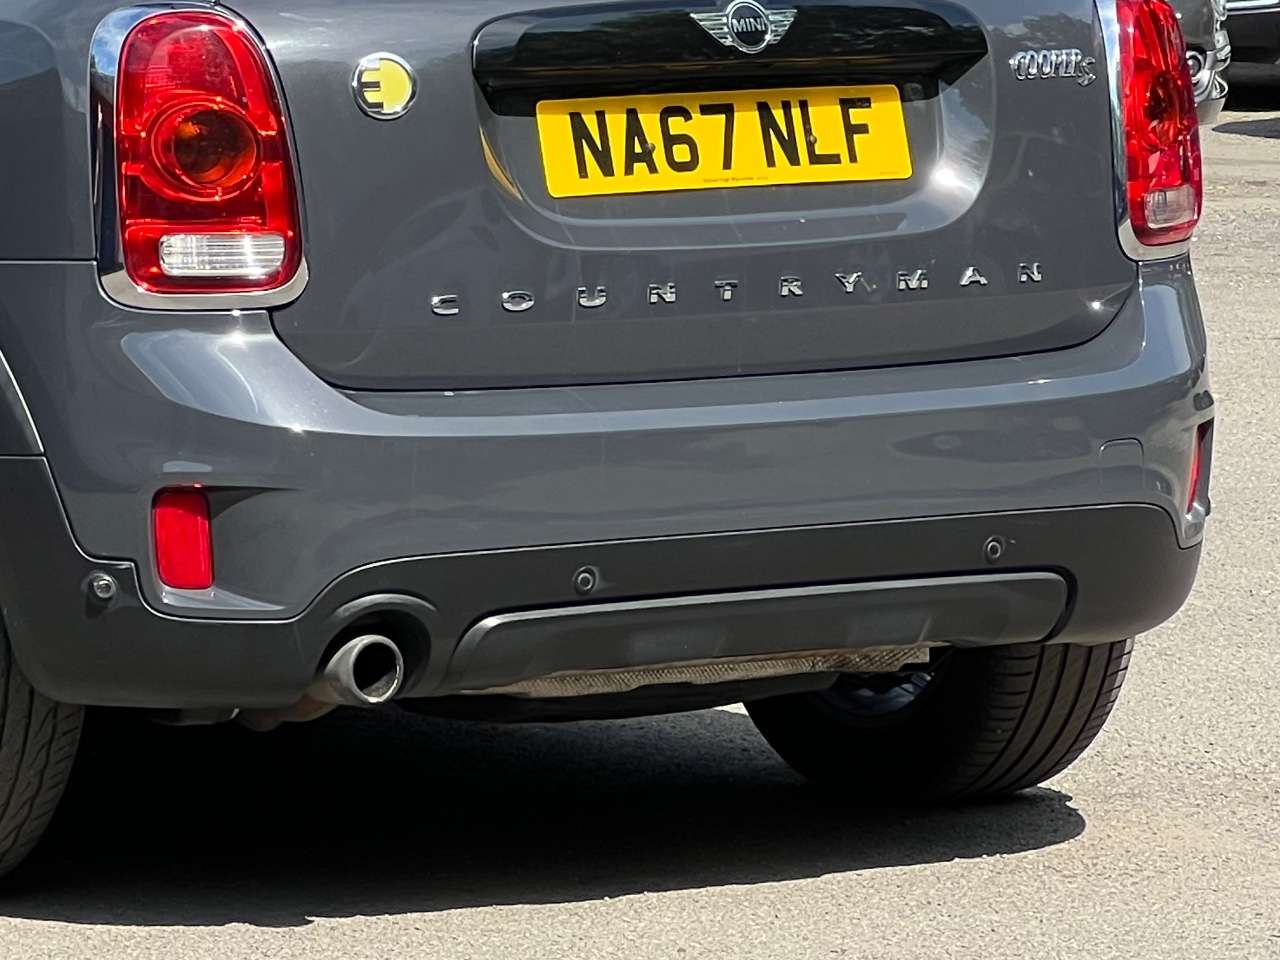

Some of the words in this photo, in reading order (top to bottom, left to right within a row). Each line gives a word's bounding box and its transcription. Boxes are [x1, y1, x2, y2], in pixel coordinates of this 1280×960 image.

[731, 17, 766, 33] MINI
[1008, 49, 1082, 80] COOPER
[568, 102, 734, 180] NA67
[756, 97, 872, 168] NLF
[430, 262, 1042, 316] COUNTRYMAN
